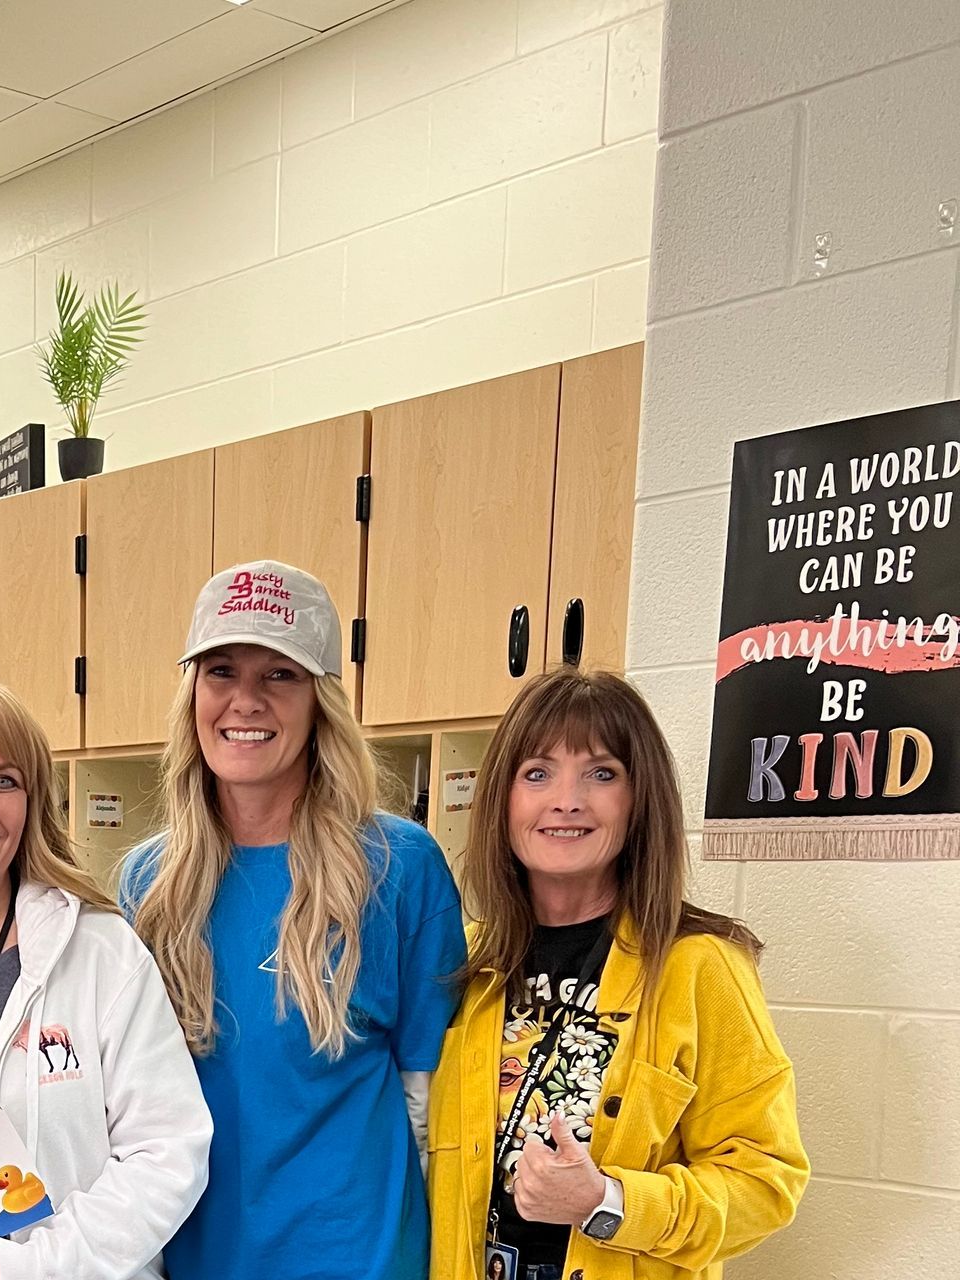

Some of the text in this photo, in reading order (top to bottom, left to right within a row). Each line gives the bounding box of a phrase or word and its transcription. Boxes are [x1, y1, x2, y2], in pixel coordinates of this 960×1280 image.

[771, 440, 960, 506] IN A WORLD
[767, 491, 954, 552] WHERE YOU
[229, 581, 292, 600] Barrett
[798, 545, 917, 594] CAN BE
[217, 597, 295, 625] Saddlery
[740, 601, 960, 674] anything
[819, 679, 867, 722] BE
[747, 727, 934, 802] KIND
[528, 1053, 547, 1077] North
[506, 1108, 522, 1136] School
